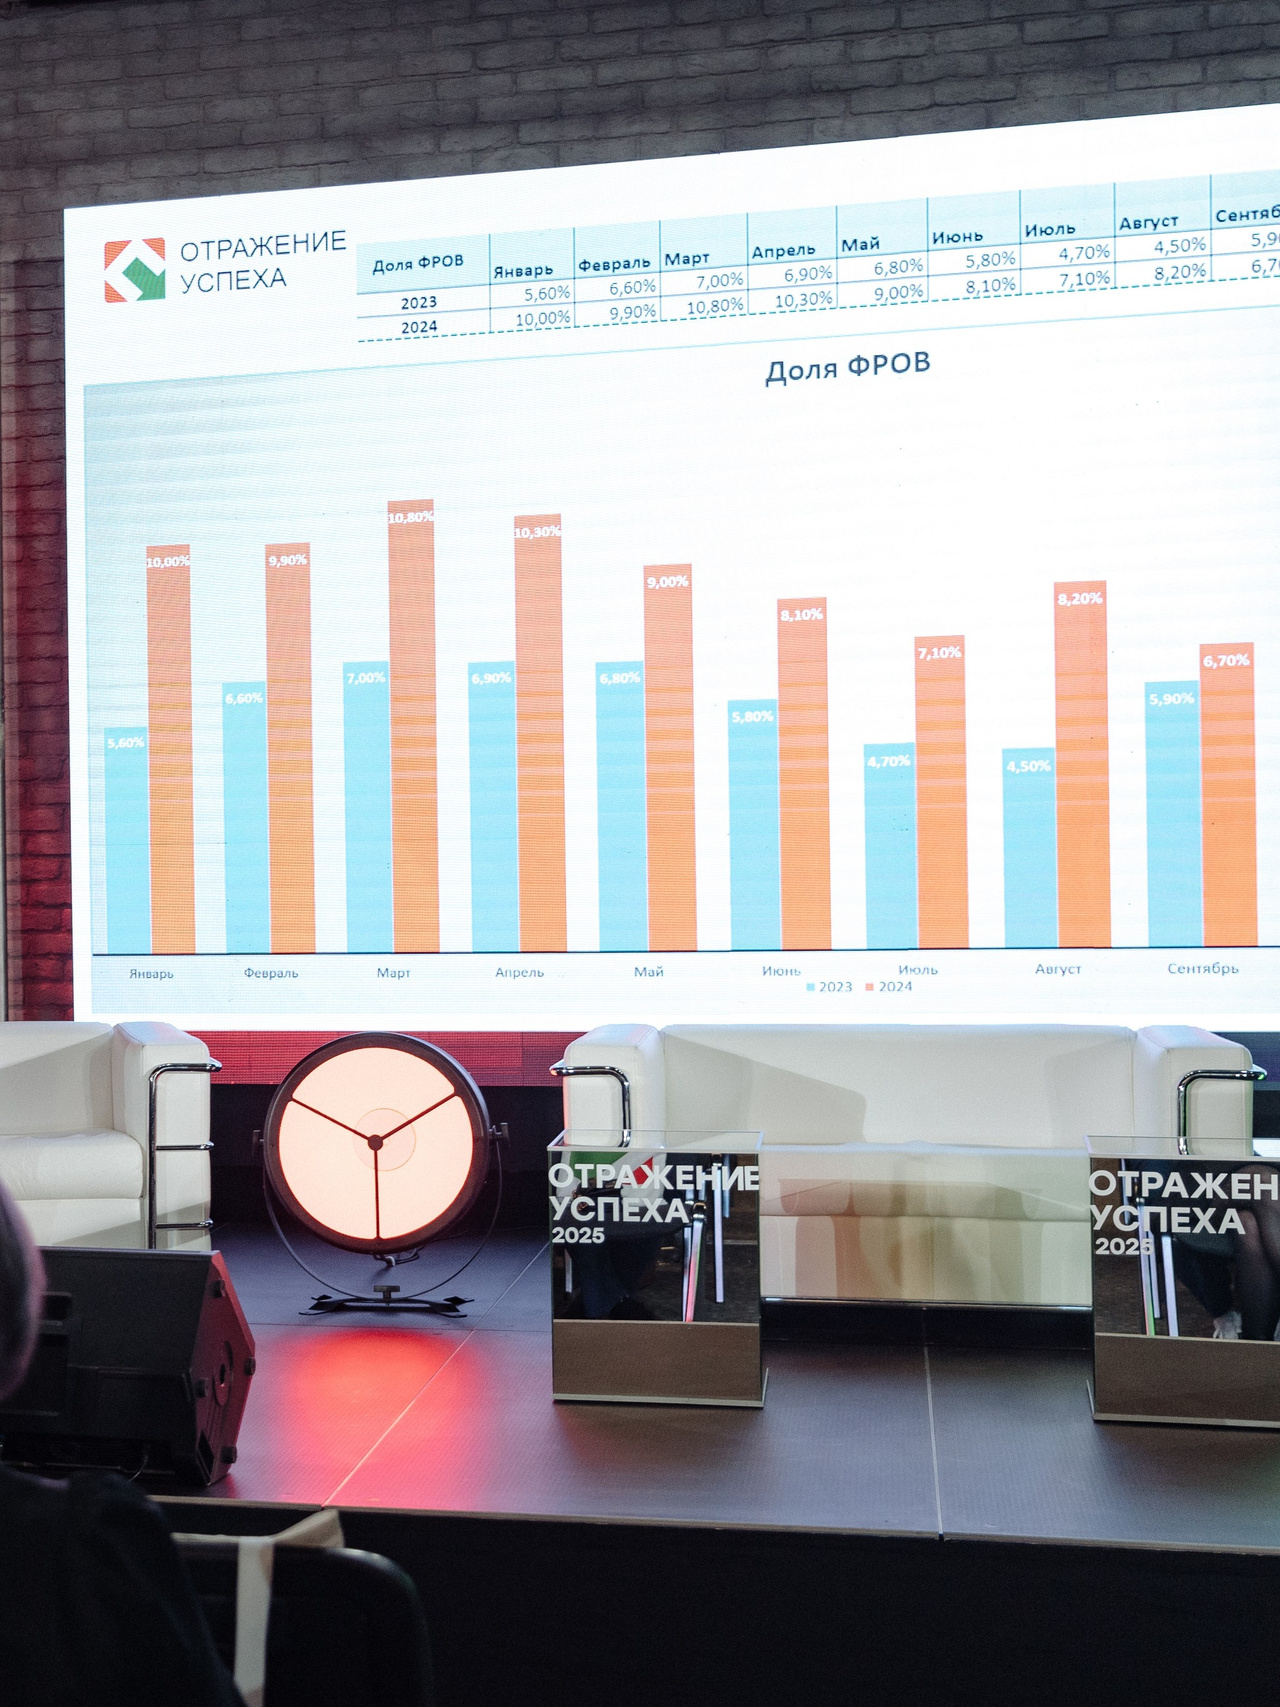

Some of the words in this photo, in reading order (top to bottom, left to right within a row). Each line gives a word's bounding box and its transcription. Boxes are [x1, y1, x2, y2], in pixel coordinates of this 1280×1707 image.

[180, 229, 347, 262] ОТРАЖЕНИЕ
[372, 259, 414, 276] Доля
[418, 254, 464, 269] ФРОВ
[493, 265, 554, 279] Январь
[578, 257, 651, 272] Февраль
[664, 253, 710, 267] Март
[752, 246, 816, 260] Апрель
[841, 236, 880, 252] Май
[932, 231, 984, 245] Июнь
[1025, 224, 1076, 238] Июль
[1119, 216, 1179, 231] Август
[401, 296, 438, 310] 2023
[524, 284, 571, 303] 5,60%
[609, 278, 657, 297] 6,60%
[696, 272, 744, 291] 7,00%
[784, 265, 833, 284] 6,90%
[874, 258, 924, 277] 6,80%
[965, 251, 1016, 270] 5,80%
[1058, 244, 1110, 263] 4,70%
[1154, 236, 1207, 256] 4,50%
[1251, 231, 1280, 249] 5,9
[180, 267, 288, 294] УСПЕХА
[401, 320, 438, 334] 2024
[516, 309, 571, 328] 10,00%
[609, 304, 657, 322] 9,90%
[687, 297, 744, 316] 10,80%
[775, 290, 833, 309] 10,30%
[874, 284, 924, 303] 9,00%
[965, 277, 1016, 297] 8,10%
[1059, 270, 1110, 290] 7,10%
[1154, 263, 1207, 283] 8,20%
[1251, 258, 1280, 276] 6,7
[765, 360, 838, 388] Доля
[848, 351, 932, 377] ФРОВ
[387, 510, 435, 525] 10,80%
[513, 525, 562, 540] 10,30%
[145, 555, 191, 570] 10,00%
[268, 554, 308, 568] 9,90%
[646, 576, 689, 590] 9,00%
[1057, 592, 1104, 607] 8,20%
[780, 608, 823, 622] 8,10%
[917, 646, 962, 661] 7,10%
[1202, 653, 1251, 668] 6,70%
[346, 671, 386, 686] 7,00%
[471, 671, 512, 686] 6,90%
[599, 671, 641, 686] 6,80%
[224, 692, 264, 706] 6,60%
[1148, 692, 1195, 707] 5,90%
[731, 710, 774, 725] 5,80%
[107, 736, 145, 750] 5,60%
[867, 755, 911, 770] 4,70%
[1006, 760, 1052, 775] 4,50%
[129, 967, 174, 981] Январь
[243, 966, 299, 980] Февраль
[376, 966, 412, 980] Март
[495, 966, 545, 980] Апрель
[634, 965, 665, 978] Май
[762, 965, 802, 977] Июнь
[898, 964, 939, 976] Июль
[1035, 963, 1082, 977] Август
[1167, 962, 1240, 977] Сентябрь
[819, 981, 853, 994] 2023
[879, 980, 913, 993] 2024
[548, 1163, 760, 1191] ОТРАЖЕНИЕ
[549, 1196, 690, 1223] УСПЕХА
[1090, 1205, 1246, 1235] УСПЕХА
[551, 1227, 605, 1243] 2025
[1095, 1237, 1155, 1255] 2025
